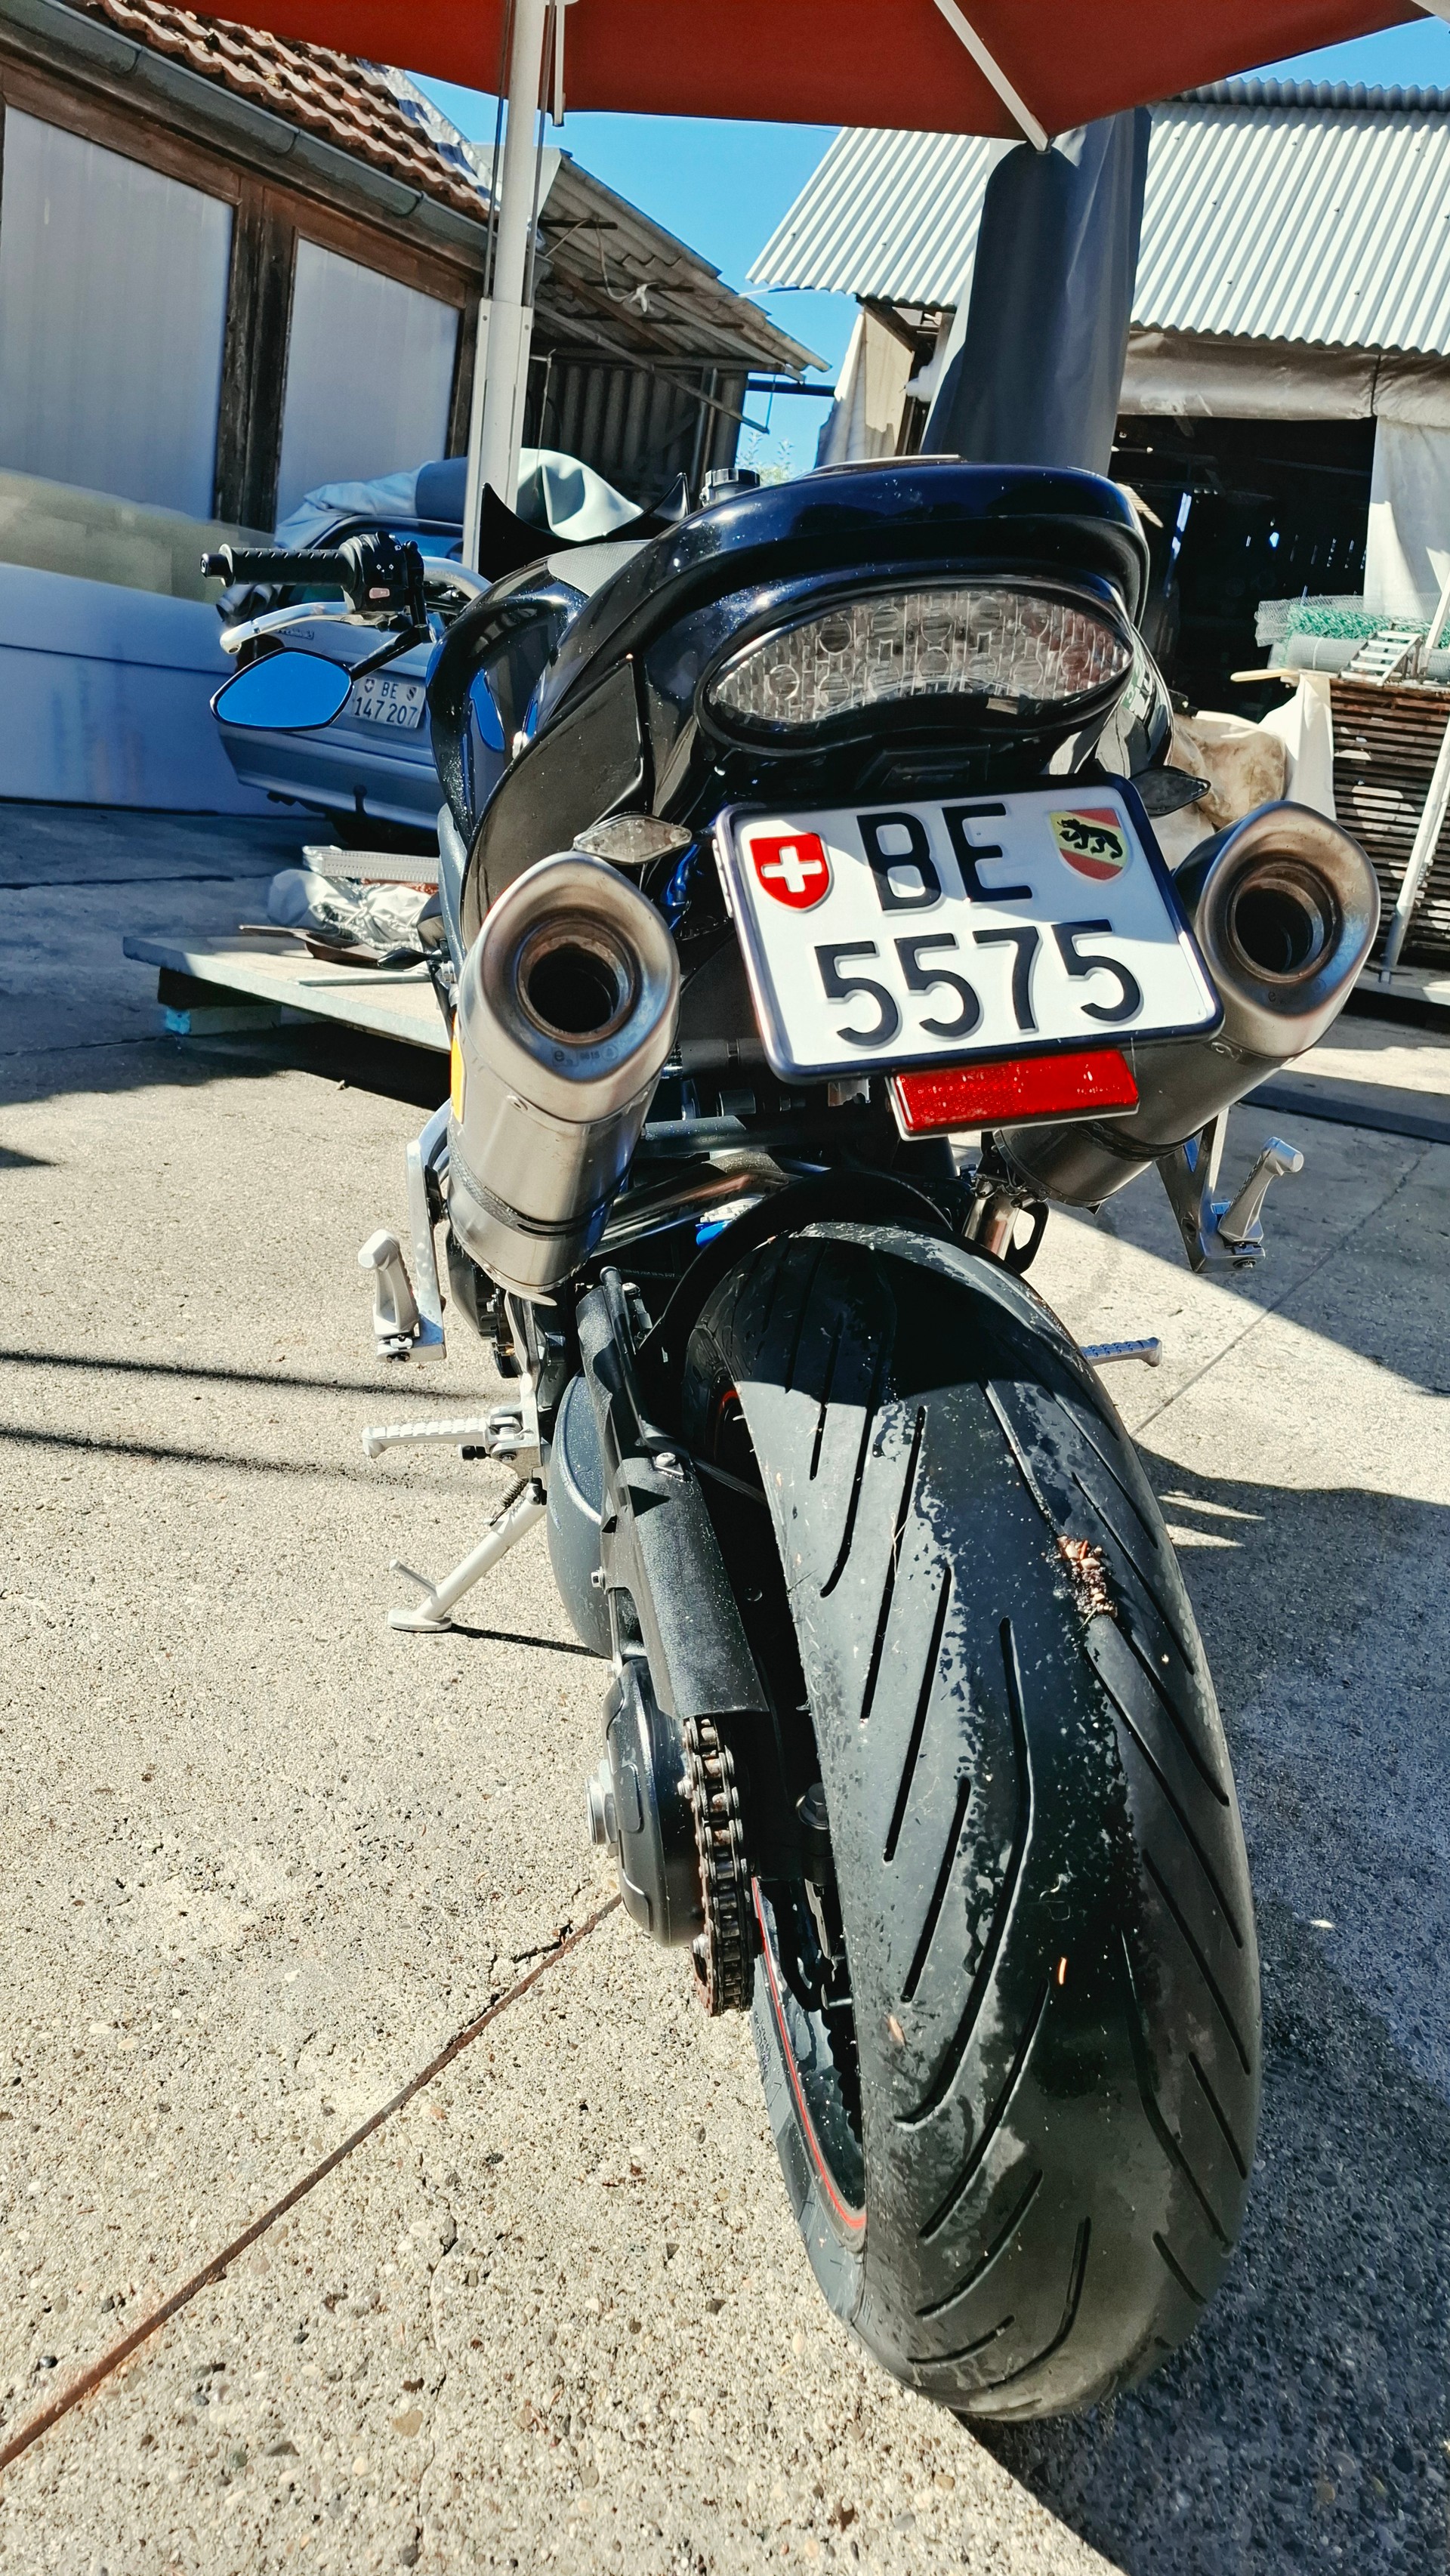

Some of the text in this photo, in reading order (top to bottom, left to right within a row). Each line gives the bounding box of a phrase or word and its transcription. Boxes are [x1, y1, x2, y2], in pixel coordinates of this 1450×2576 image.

[354, 696, 418, 725] 147 207
[381, 681, 400, 699] BE
[856, 803, 1033, 911] BE
[814, 919, 1141, 1047] 5575
